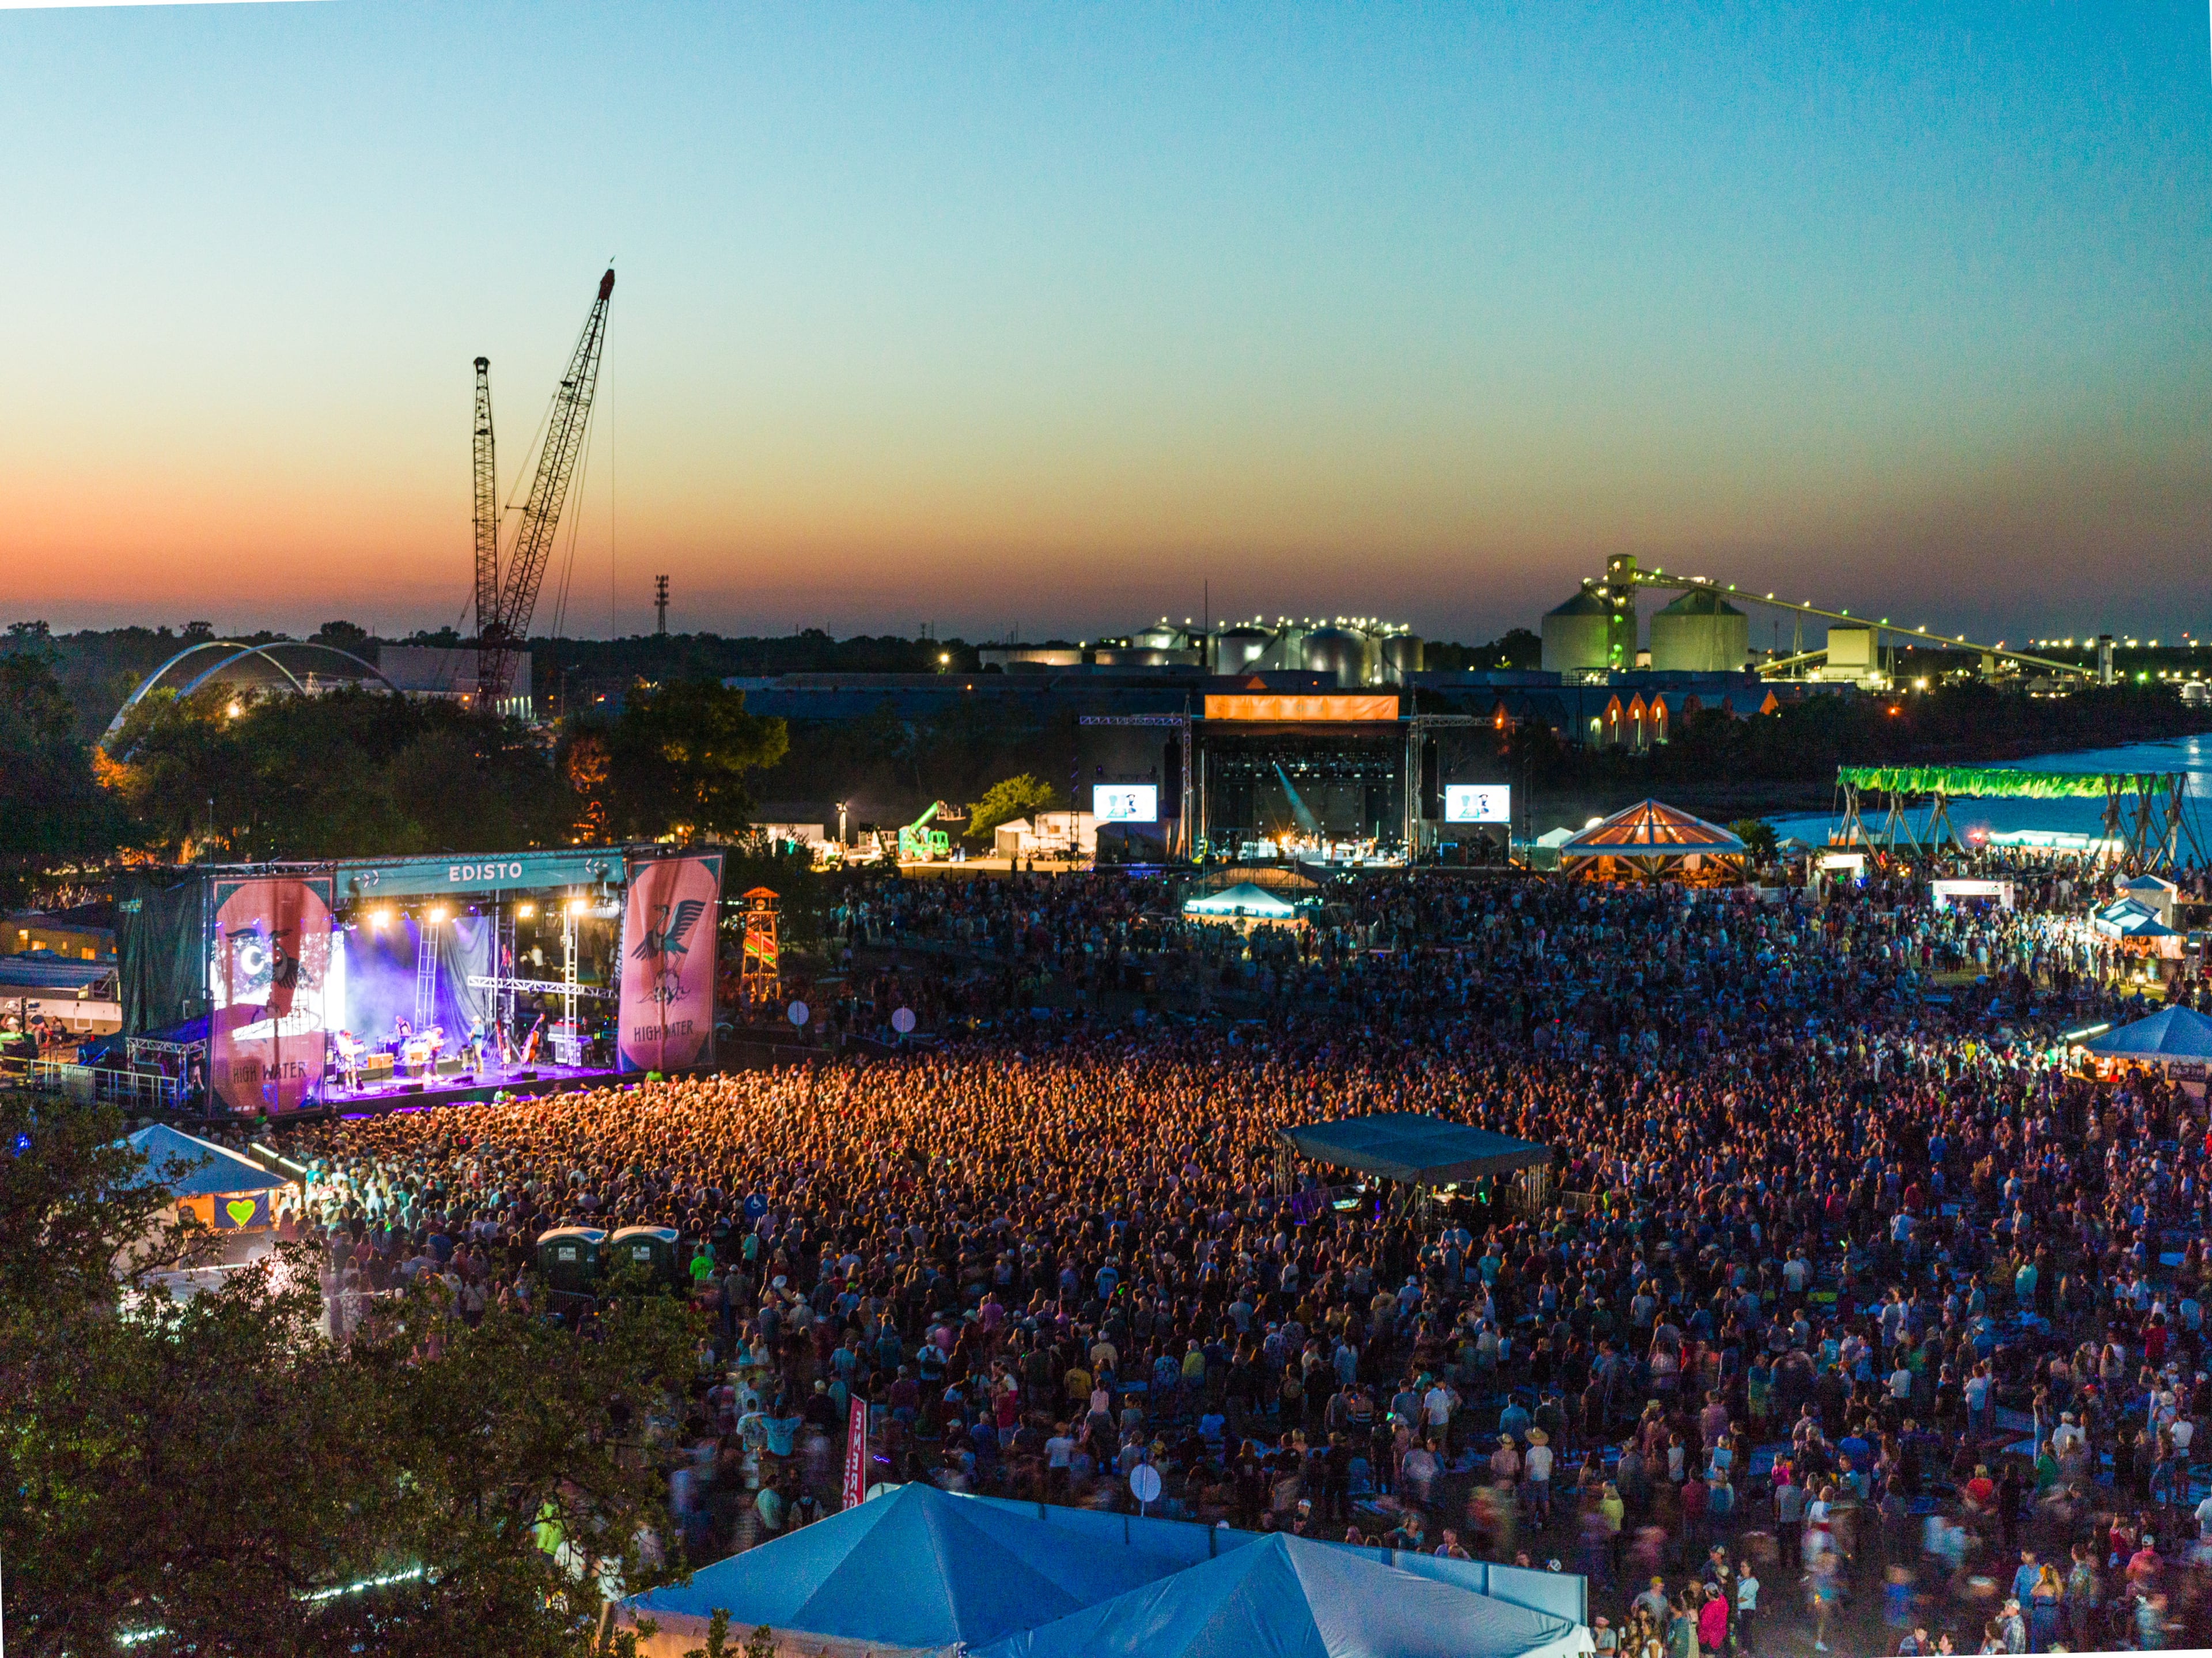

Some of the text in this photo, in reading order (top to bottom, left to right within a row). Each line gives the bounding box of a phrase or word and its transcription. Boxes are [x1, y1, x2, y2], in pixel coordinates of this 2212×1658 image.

[449, 862, 522, 882] EDISTO
[634, 1025, 661, 1042] HIGH
[233, 1062, 307, 1083] HIGH WATER
